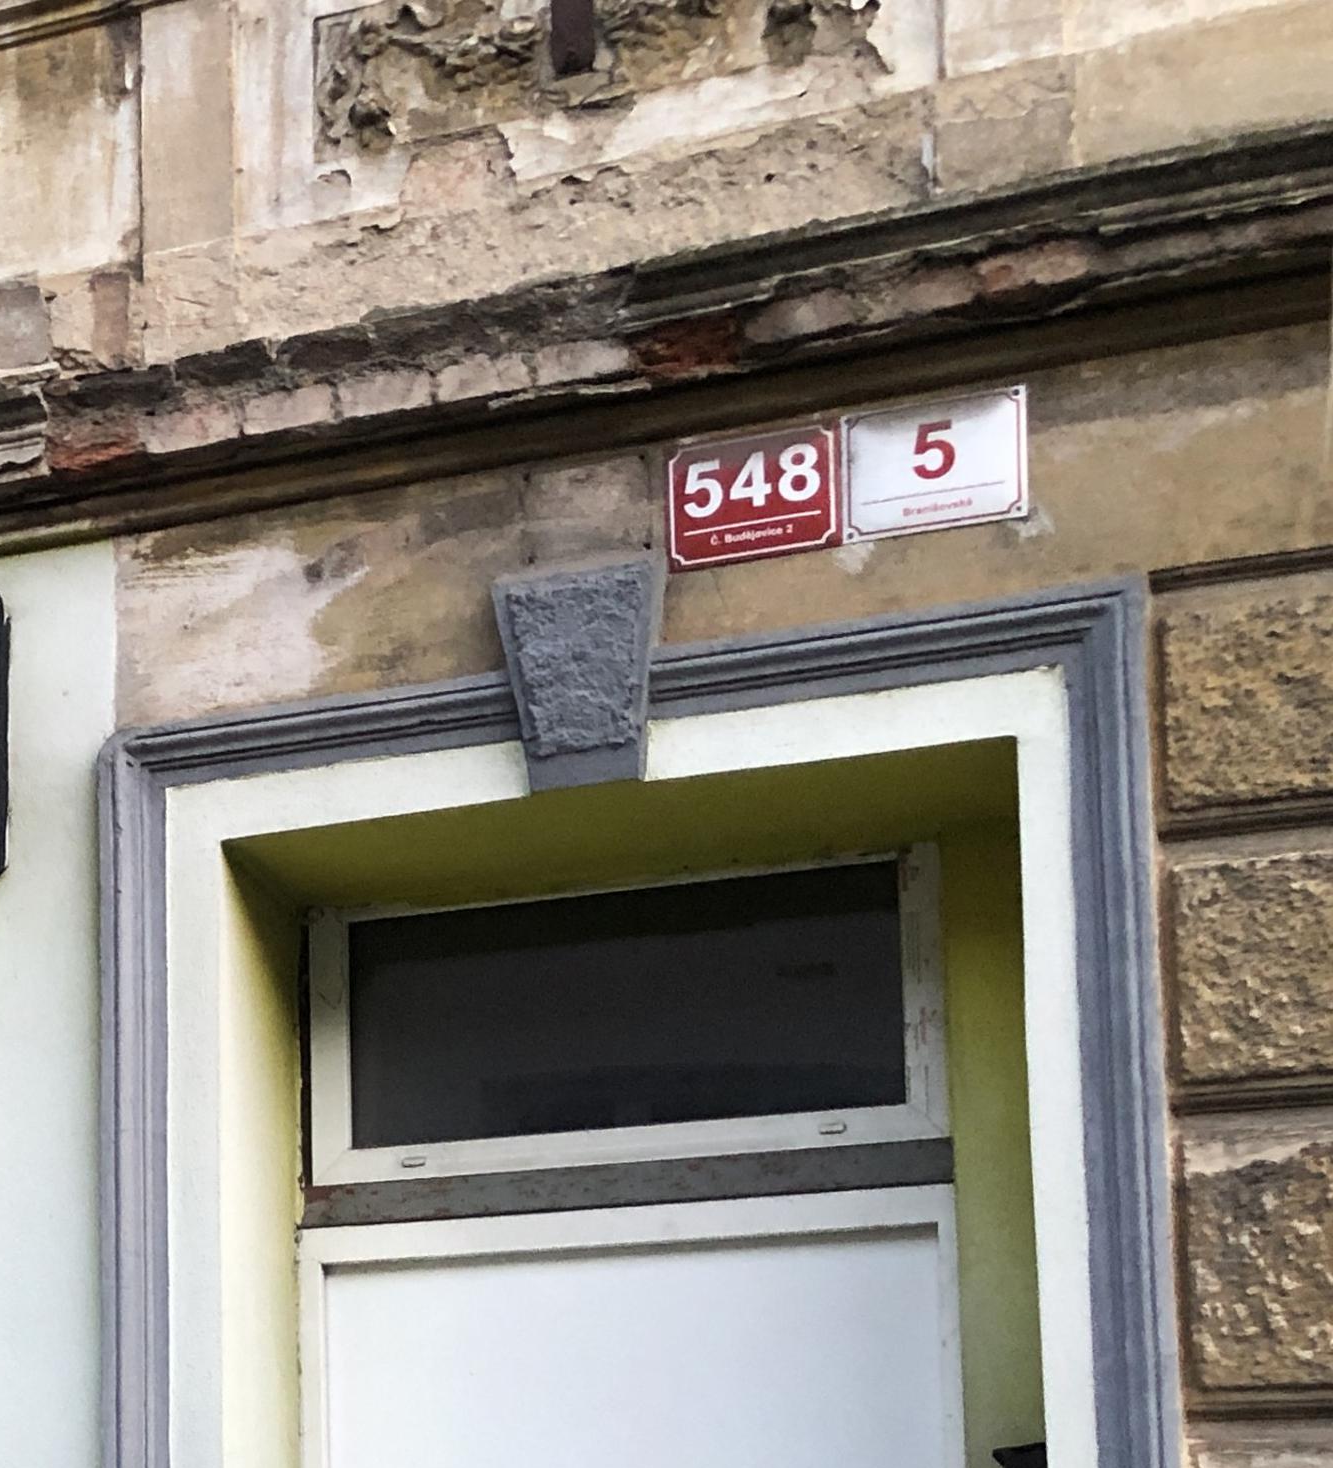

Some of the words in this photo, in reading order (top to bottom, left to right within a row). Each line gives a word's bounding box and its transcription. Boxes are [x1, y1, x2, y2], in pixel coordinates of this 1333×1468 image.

[682, 442, 822, 520] 548
[912, 419, 956, 481] 5
[724, 526, 784, 544] Budějovice
[785, 523, 794, 534] 2
